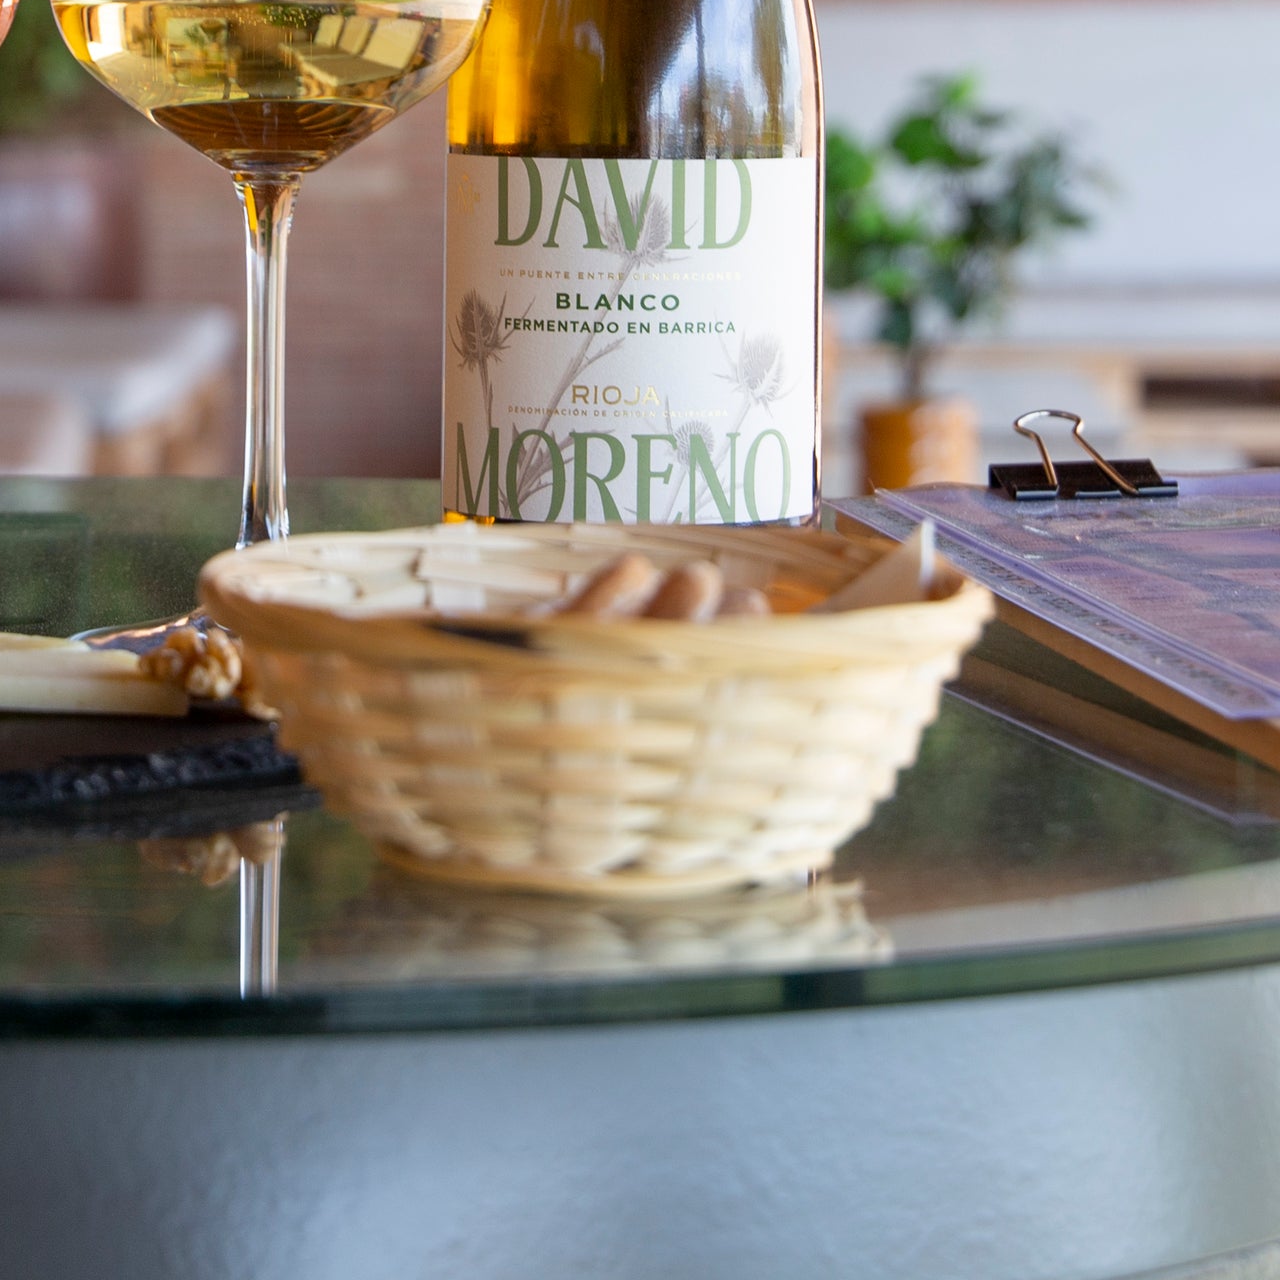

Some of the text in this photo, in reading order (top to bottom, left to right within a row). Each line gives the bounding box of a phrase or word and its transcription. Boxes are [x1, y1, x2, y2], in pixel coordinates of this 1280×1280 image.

[495, 158, 752, 251] DAVID
[500, 269, 515, 278] UN
[520, 270, 570, 280] PUENTE
[577, 272, 625, 281] ENTRE
[556, 293, 680, 311] BLANCO
[504, 318, 736, 334] FERMENTADO EN BARRICA
[571, 385, 660, 406] RIOJA
[593, 409, 608, 417] DE
[456, 422, 791, 525] MORENO
